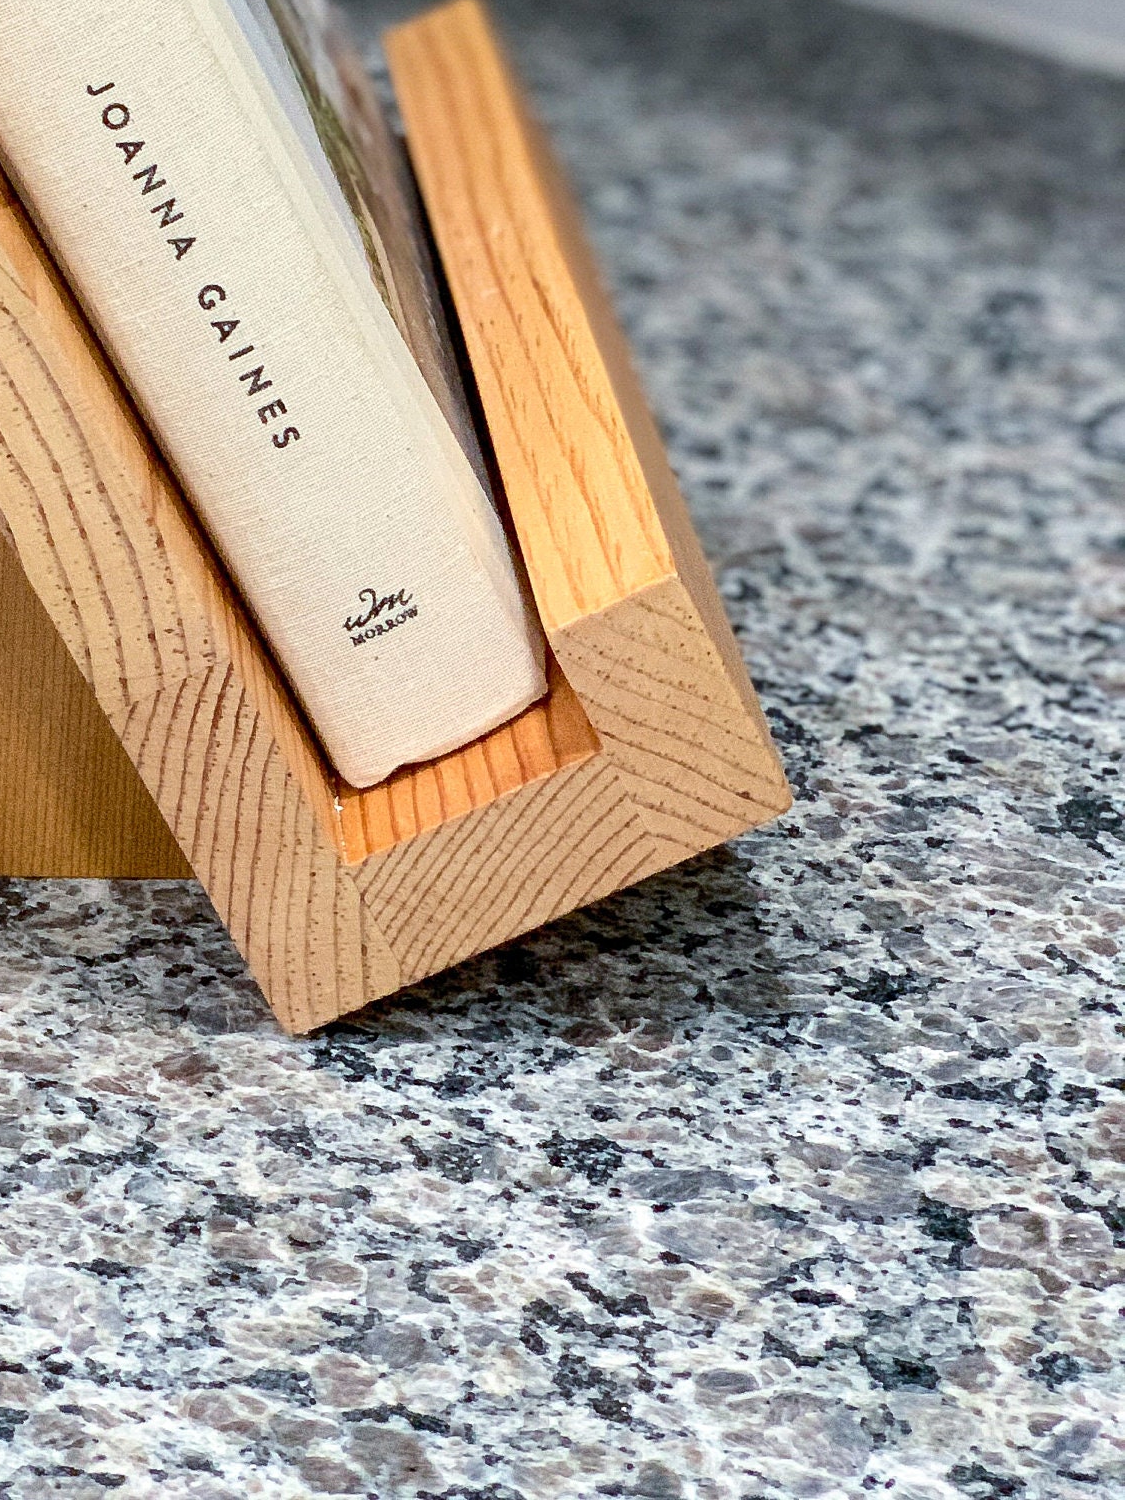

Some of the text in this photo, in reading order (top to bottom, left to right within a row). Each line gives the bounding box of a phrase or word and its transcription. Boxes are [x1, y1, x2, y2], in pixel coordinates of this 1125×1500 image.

[86, 82, 301, 449] JOANNA GAINES
[349, 605, 418, 647] MORROW
